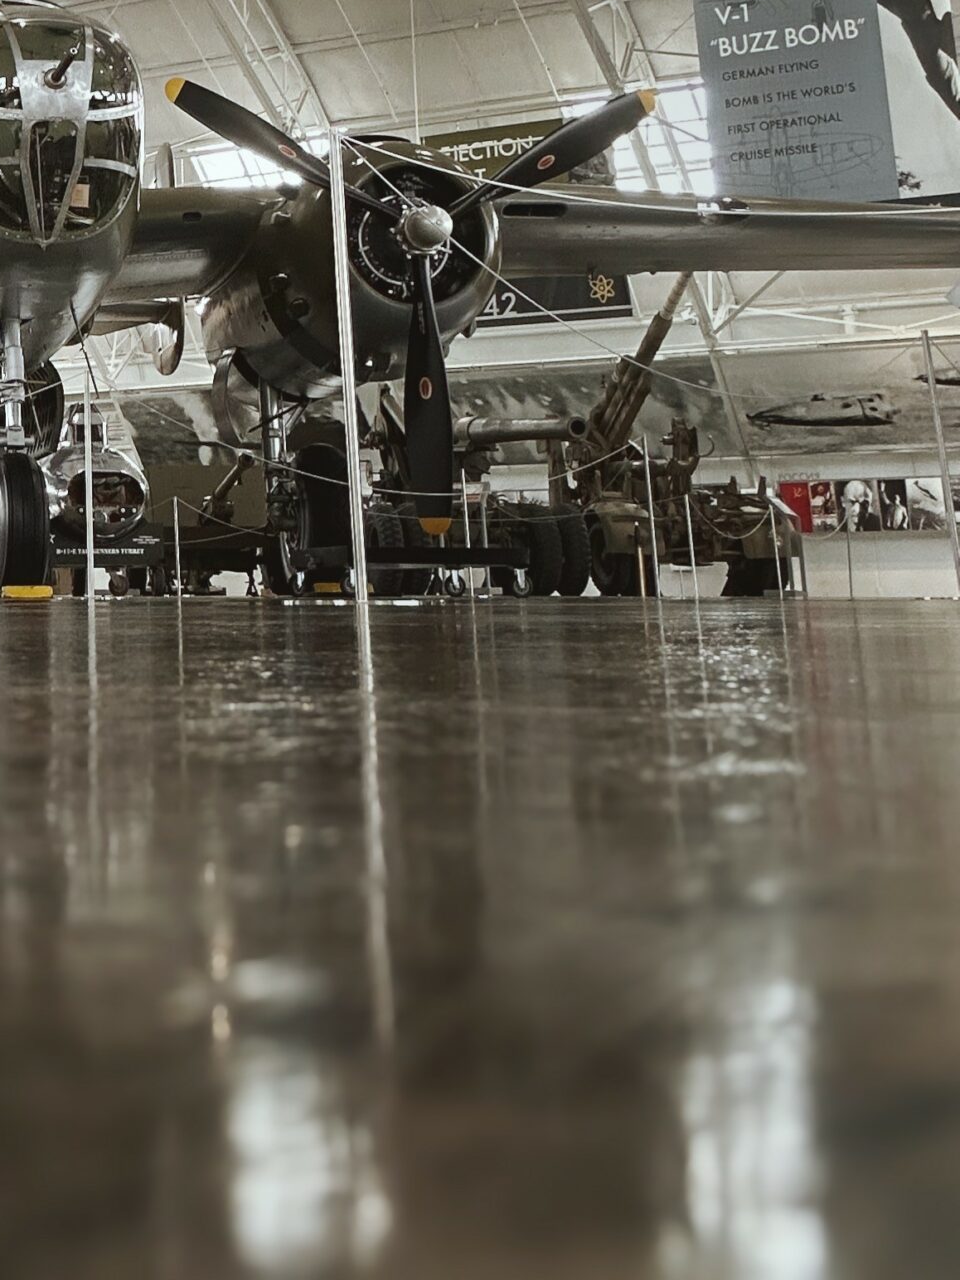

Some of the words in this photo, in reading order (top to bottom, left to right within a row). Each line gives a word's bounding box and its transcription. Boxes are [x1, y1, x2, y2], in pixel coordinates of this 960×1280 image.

[714, 3, 751, 26] V-1
[722, 64, 776, 82] GERMAN
[778, 58, 821, 76] FLYING
[724, 93, 760, 109] BOMB
[762, 91, 773, 104] IS
[776, 89, 798, 102] THE
[800, 82, 857, 99] WORLD'S
[727, 122, 756, 136] FIRST
[758, 111, 844, 132] OPERATIONAL
[730, 148, 771, 163] CRUISE
[774, 142, 820, 158] MISSILE
